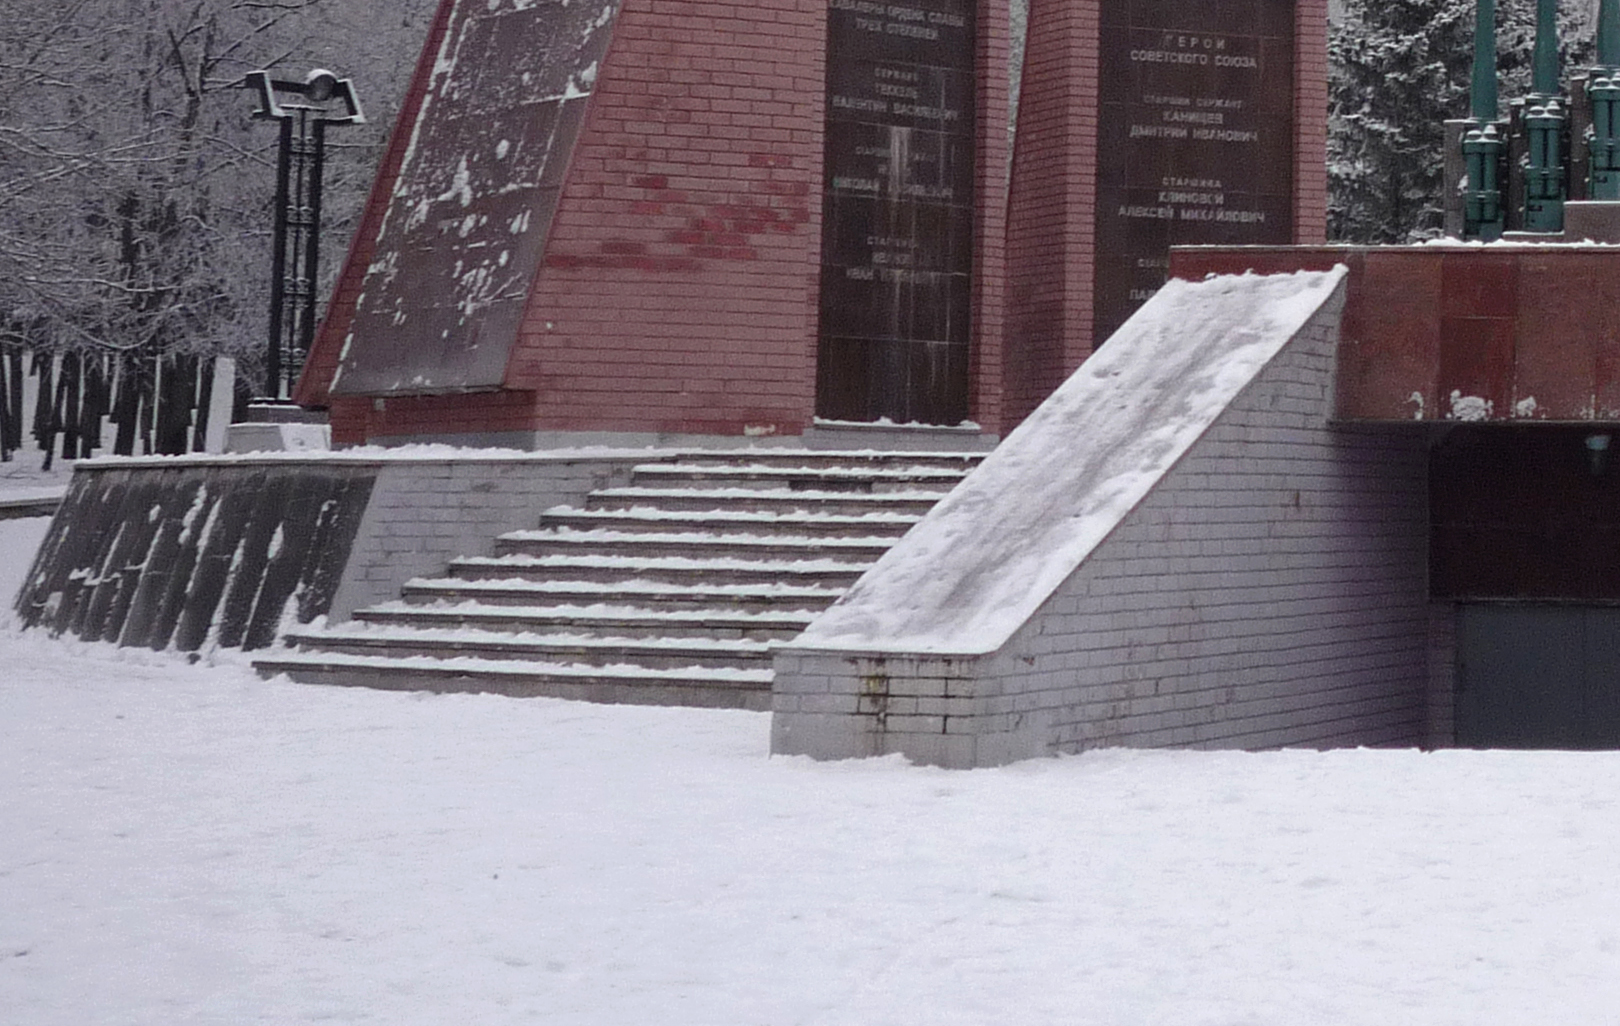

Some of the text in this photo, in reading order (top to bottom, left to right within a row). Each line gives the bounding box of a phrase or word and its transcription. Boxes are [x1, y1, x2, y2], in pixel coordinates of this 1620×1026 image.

[1130, 50, 1257, 68] СОВЕТСКОГО СОЮЗА
[1163, 110, 1224, 125] КАНИЩЕВ
[1193, 128, 1258, 142] ИВАНОВИЧ
